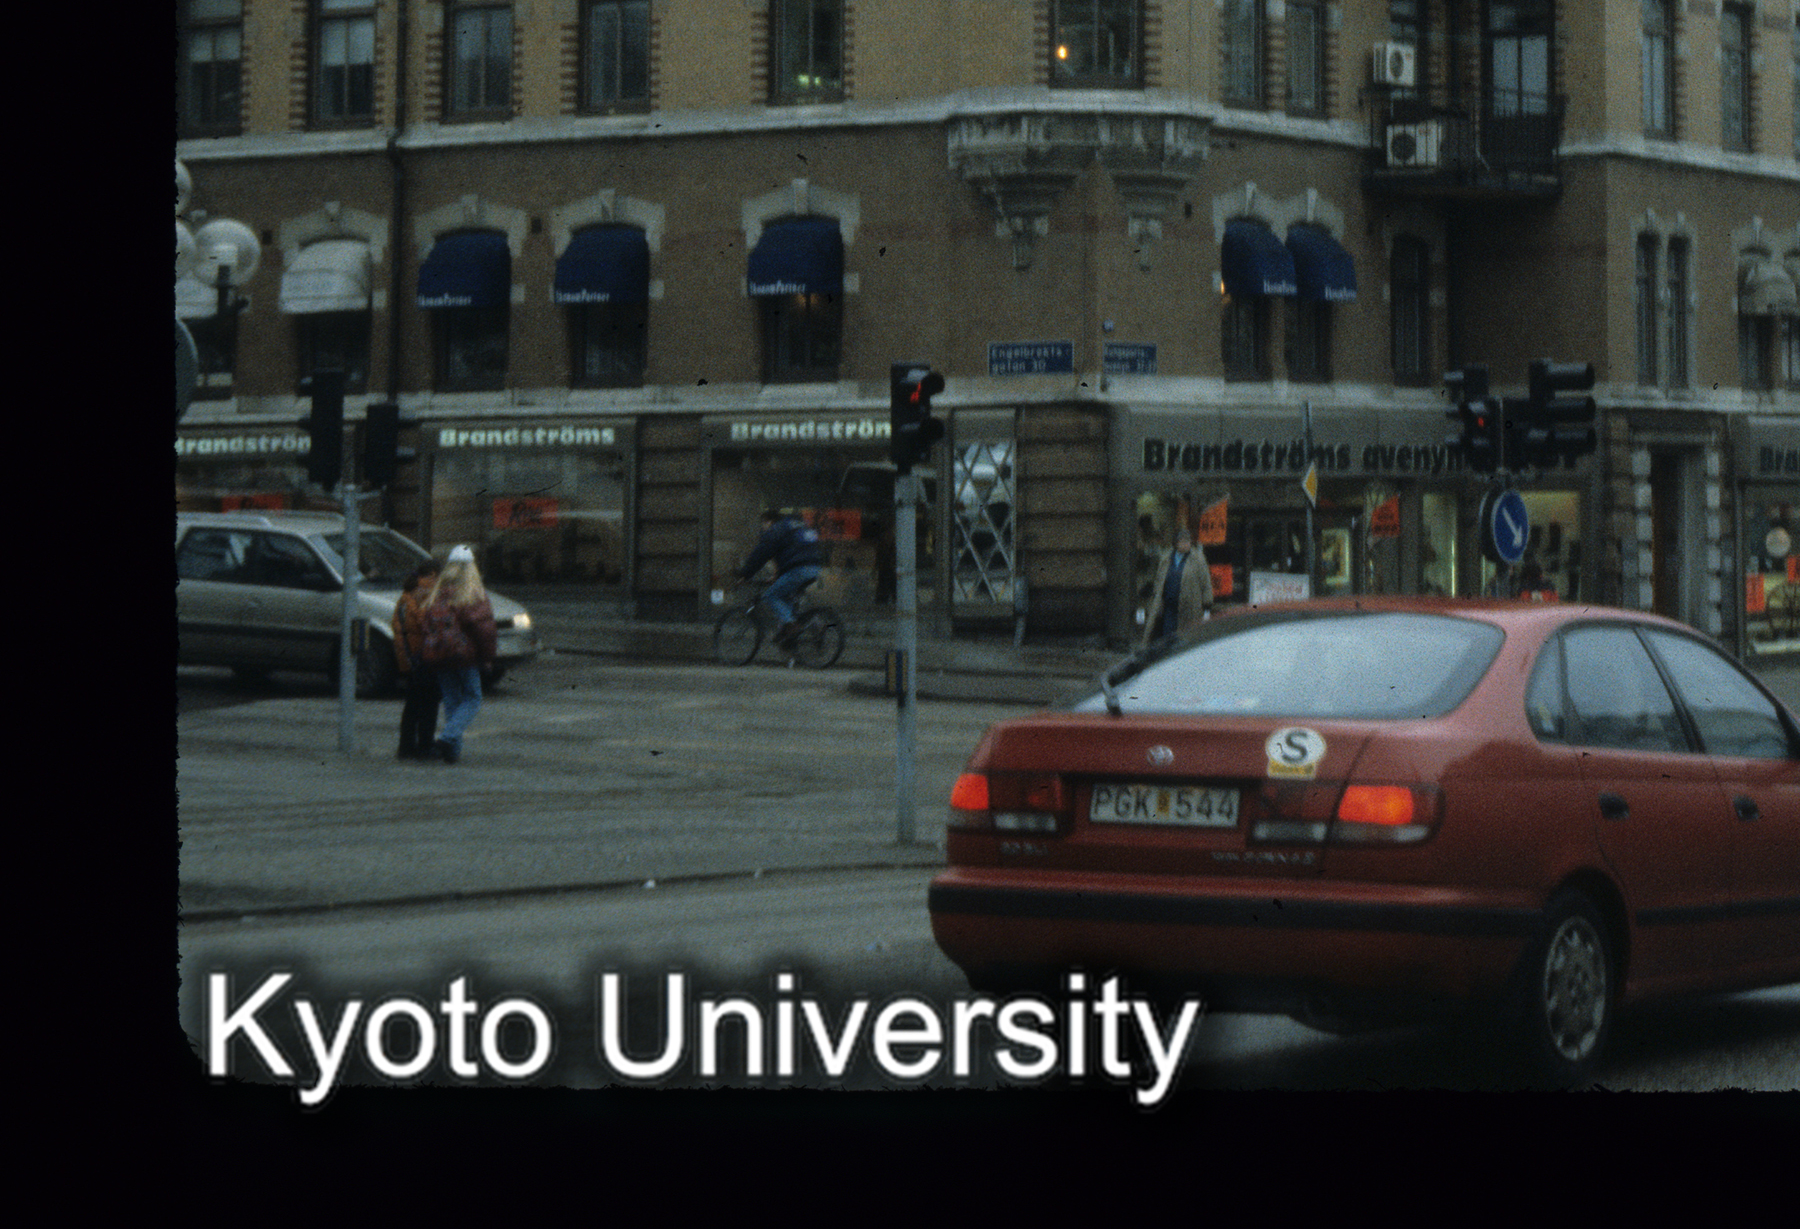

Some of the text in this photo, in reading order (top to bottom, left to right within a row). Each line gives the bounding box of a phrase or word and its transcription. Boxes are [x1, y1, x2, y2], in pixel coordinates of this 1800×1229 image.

[439, 426, 614, 447] Brandströms
[731, 419, 892, 441] Brandström
[1144, 439, 1350, 470] Brandströms
[1282, 730, 1308, 763] S
[1094, 786, 1235, 820] PGK 544
